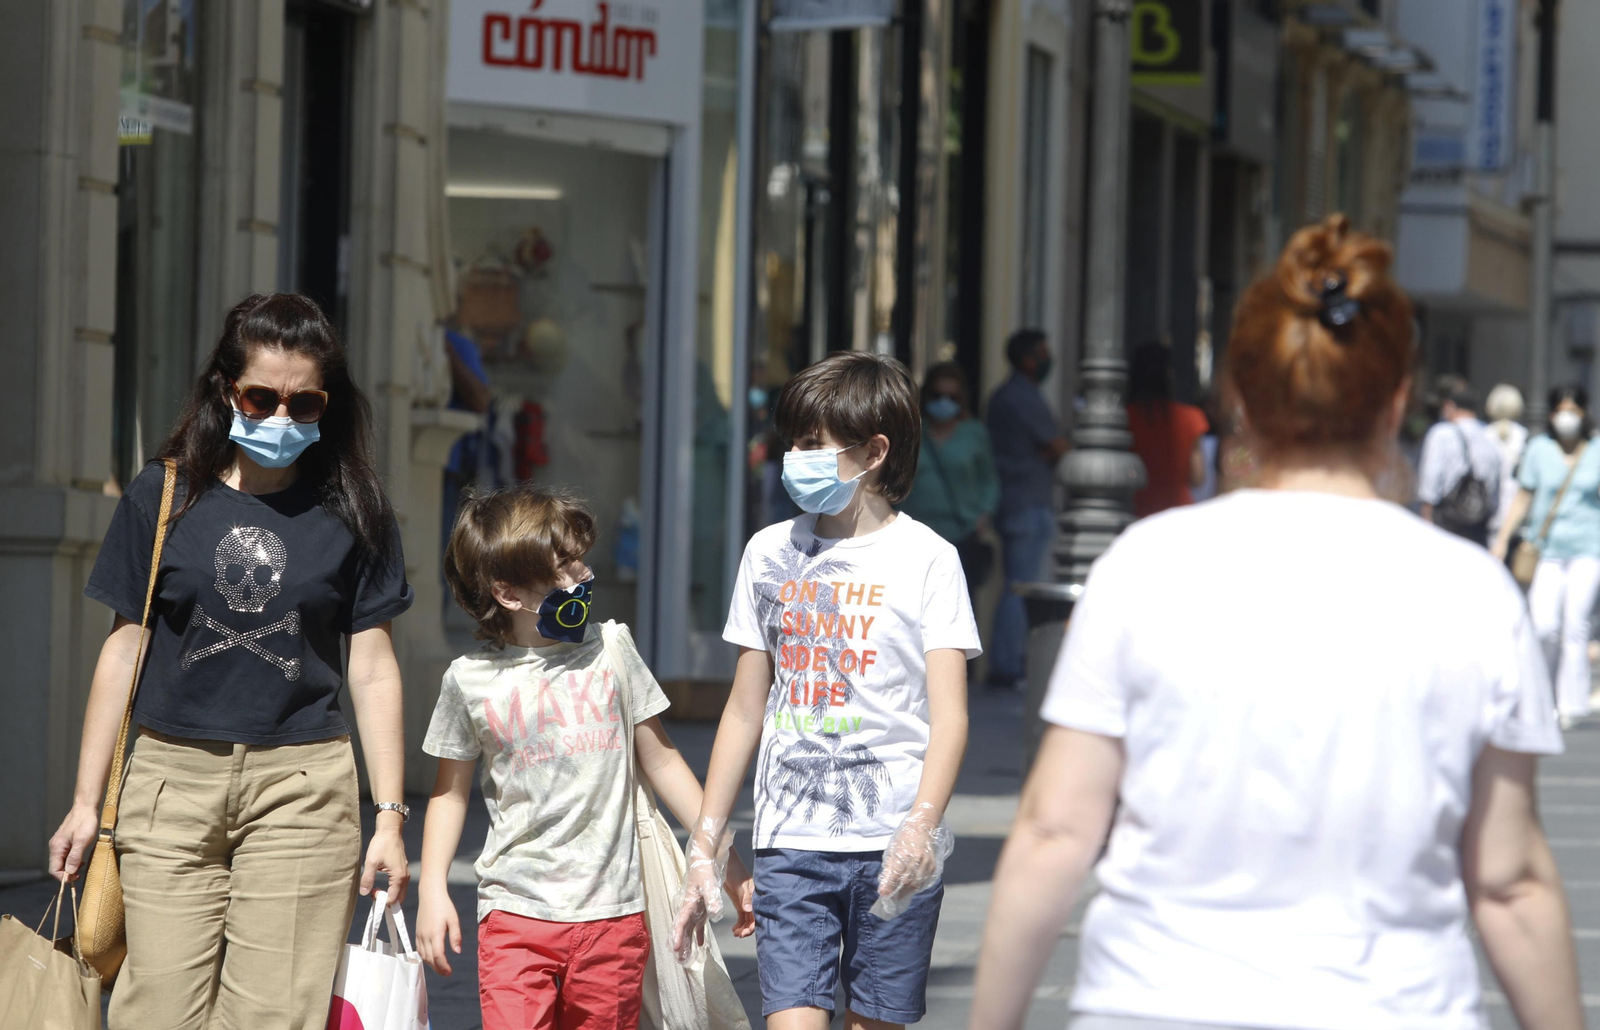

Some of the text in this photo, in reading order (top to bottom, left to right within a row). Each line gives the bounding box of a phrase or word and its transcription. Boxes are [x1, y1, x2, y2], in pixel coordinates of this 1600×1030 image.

[779, 580, 885, 606] ON THE
[782, 611, 875, 640] SUNNY
[779, 644, 877, 674] SIDE OF
[789, 679, 847, 707] LIFE
[484, 669, 620, 750] MAKE
[775, 711, 863, 733] BLUE BAY
